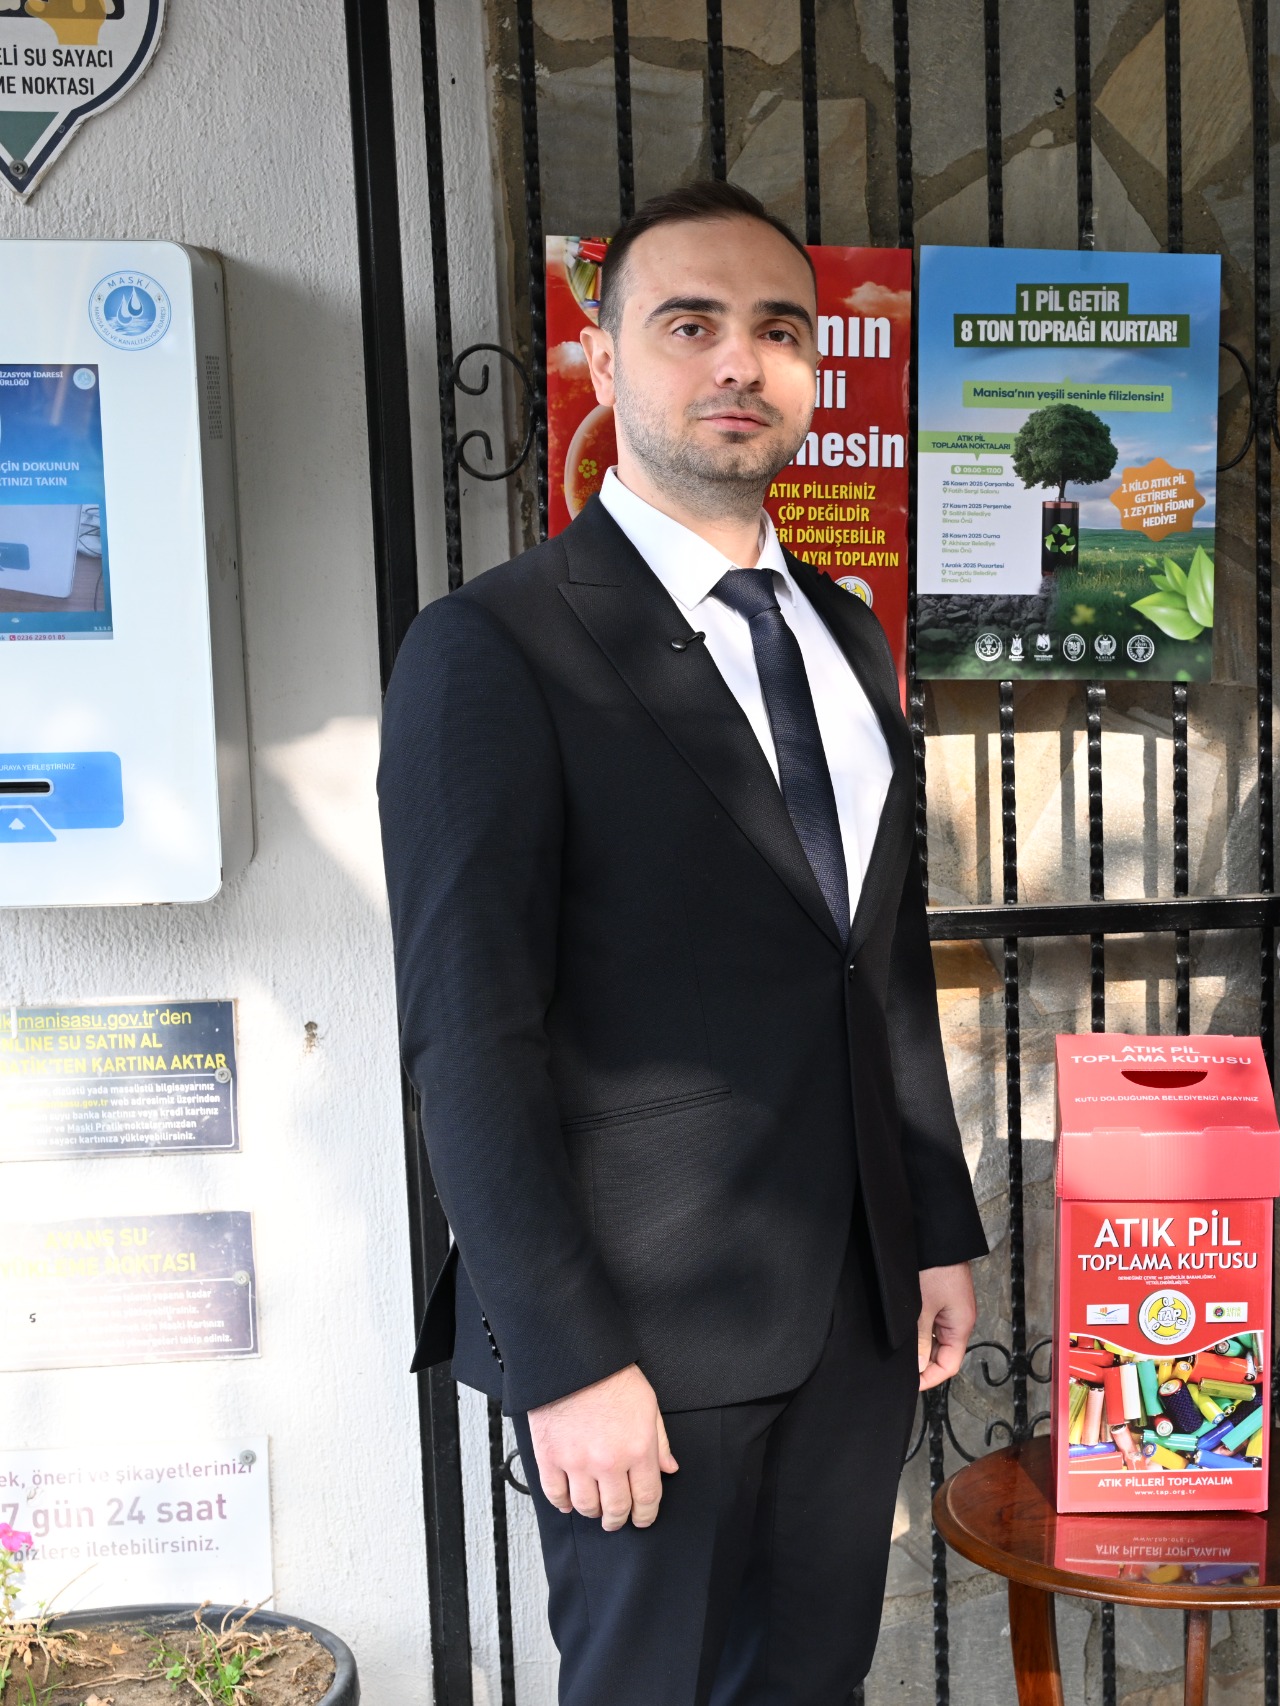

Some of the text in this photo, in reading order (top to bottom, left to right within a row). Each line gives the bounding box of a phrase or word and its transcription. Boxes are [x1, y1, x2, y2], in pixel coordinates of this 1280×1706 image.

[0, 45, 113, 67] Lİ SU SAYACI
[22, 77, 94, 95] NOKTASI
[108, 277, 150, 289] MASKİ
[1021, 286, 1120, 312] 1 PİL GETİR
[961, 316, 1178, 342] 8 TON TOPRAĞI KURTAR!
[1037, 389, 1065, 401] yeşili
[1067, 390, 1106, 400] seninle
[1108, 390, 1164, 401] filizlensin!
[23, 462, 79, 471] DOKUNUN
[0, 477, 67, 486] TINIZI TAKIN
[769, 481, 875, 499] ATIK PİLLERİNİZ
[1129, 480, 1149, 492] KİLO
[1151, 477, 1171, 489] ATIK
[1173, 473, 1186, 485] PİL
[1135, 489, 1177, 503] GETİRENE
[778, 504, 870, 524] ÇÖP DEĞİLDİR
[1131, 502, 1163, 516] ZEYTİN
[1165, 499, 1194, 512] FİDANI
[1143, 513, 1176, 527] HEDİYE!
[797, 526, 885, 546] DÖNÜŞEBİLİR
[802, 551, 831, 565] AYRI
[835, 551, 899, 566] TOPLAYIN
[23, 763, 75, 771] YERLEŞTİRİNİZ
[59, 1035, 80, 1050] SU
[86, 1033, 135, 1049] SATIN
[141, 1033, 162, 1047] AL
[1121, 1046, 1200, 1054] ATIK PİL
[92, 1056, 166, 1072] KARTINA
[171, 1053, 226, 1069] AKTAR
[1071, 1055, 1252, 1064] TOPLAMA KUTUSU
[1094, 1210, 1241, 1247] ATIK PİL
[45, 1228, 147, 1249] AVANS SU
[105, 1253, 196, 1273] NOKTASI
[1078, 1253, 1257, 1271] TOPLAMA KUTUSU
[1158, 1309, 1181, 1322] TAP
[32, 1469, 82, 1486] öneri
[90, 1470, 109, 1483] ve
[1098, 1476, 1232, 1487] ATIK PİLLERİ TOPLAYALIM
[1, 1493, 227, 1537] 7 gün 24 saat
[87, 1536, 219, 1557] iletebilirsiniz.
